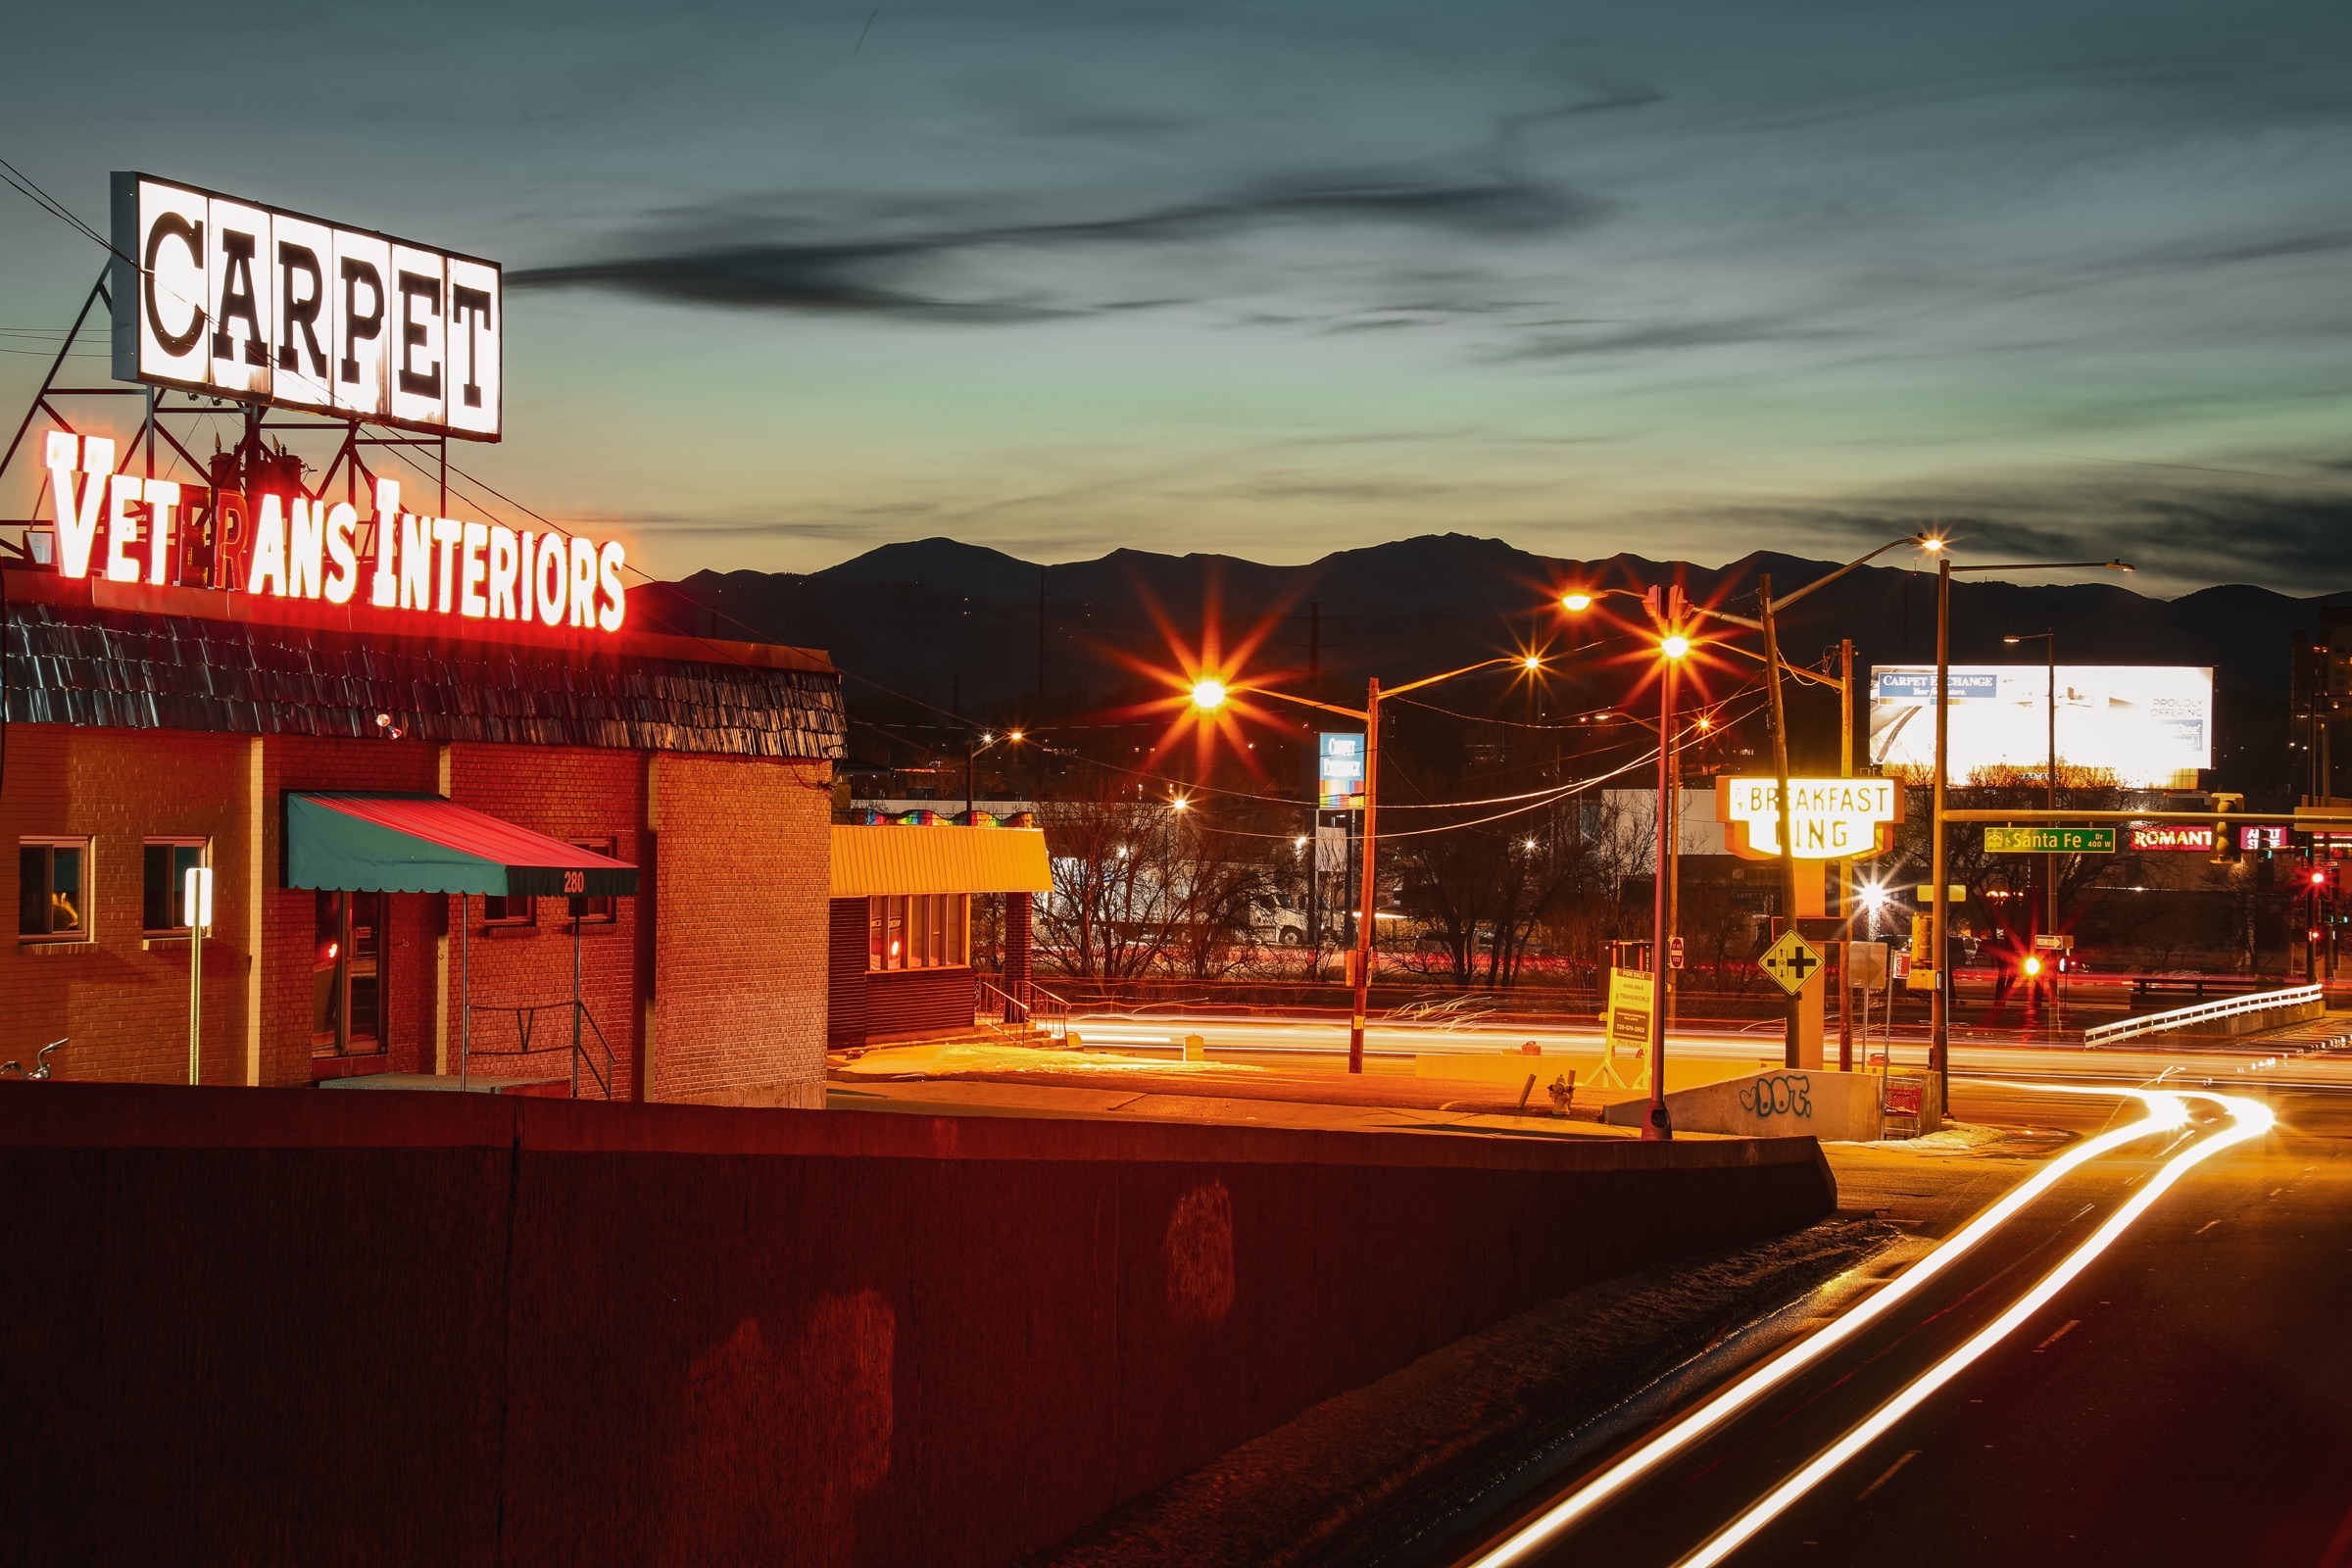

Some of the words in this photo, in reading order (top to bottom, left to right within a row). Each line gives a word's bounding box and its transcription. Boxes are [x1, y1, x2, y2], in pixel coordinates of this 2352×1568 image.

[144, 212, 491, 408] CARPET
[47, 430, 357, 604] VETERANS
[372, 477, 625, 632] INTERIORS
[1883, 675, 1928, 686] CARPET
[1930, 676, 1993, 687] ECHANGE
[1751, 787, 1888, 812] BRAKFAST
[1776, 819, 1847, 849] ING
[2013, 832, 2057, 848] Santa
[2064, 833, 2082, 848] Fe
[2134, 830, 2212, 847] ROMANT
[564, 871, 584, 893] 280
